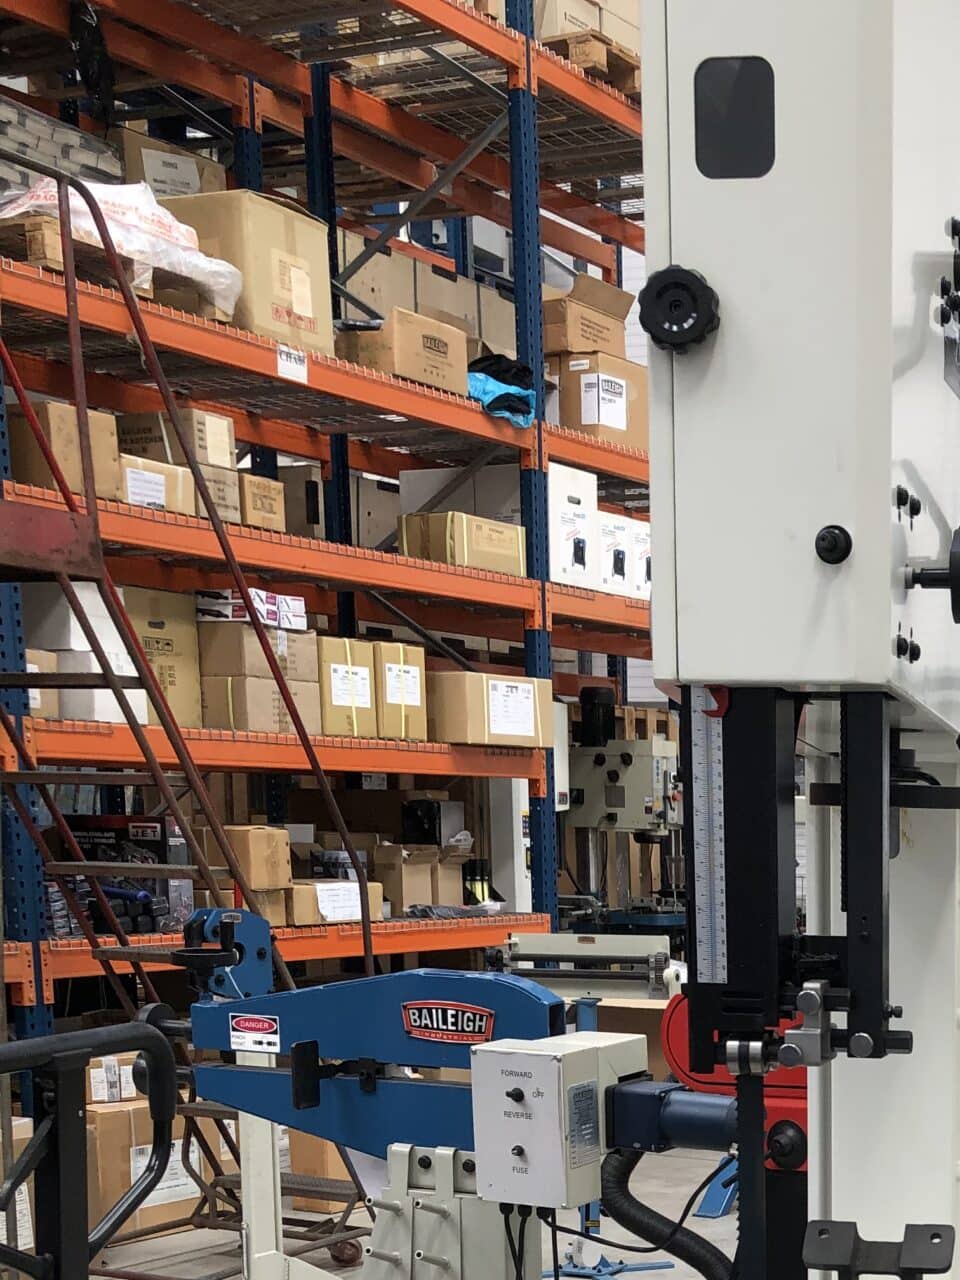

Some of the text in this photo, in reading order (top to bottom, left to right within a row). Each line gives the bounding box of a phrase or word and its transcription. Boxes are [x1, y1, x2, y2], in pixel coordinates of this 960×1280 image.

[132, 830, 158, 838] JET
[239, 1020, 269, 1029] DANGER
[408, 1008, 487, 1033] BAILEIGH
[501, 1069, 533, 1079] FORWARD
[503, 1110, 534, 1120] REVERSE
[512, 1166, 529, 1175] FUSE
